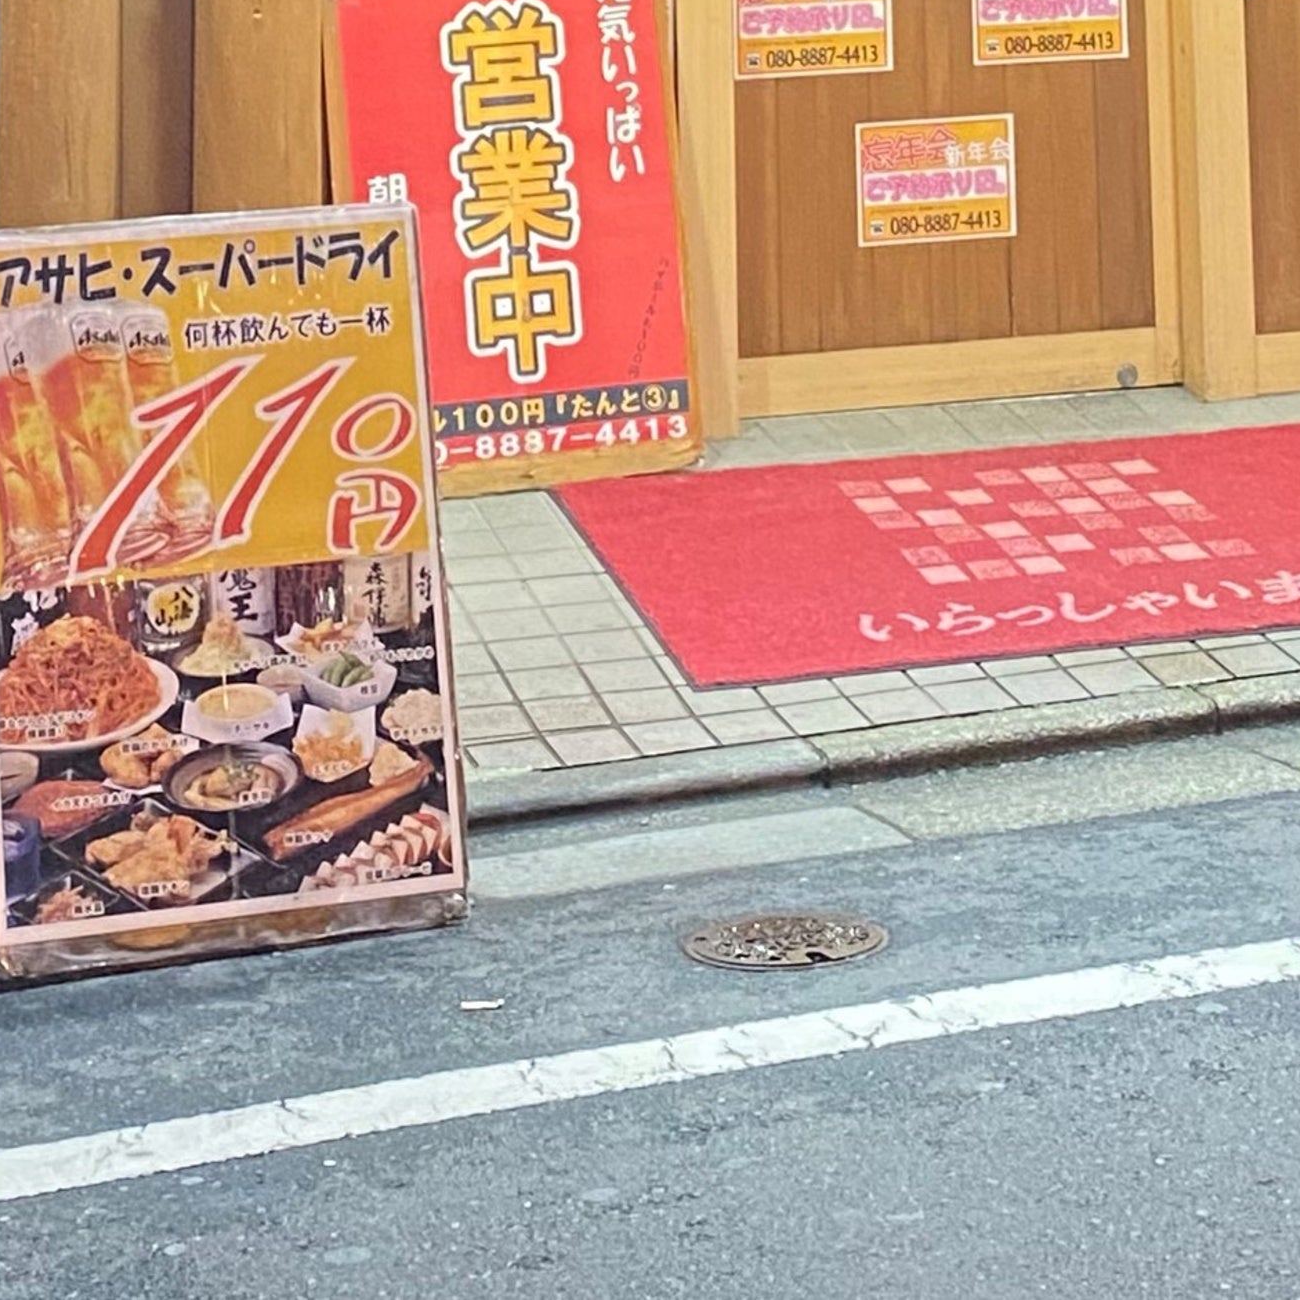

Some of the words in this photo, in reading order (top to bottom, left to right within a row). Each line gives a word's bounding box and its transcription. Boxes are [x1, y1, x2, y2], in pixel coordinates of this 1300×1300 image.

[1004, 31, 1114, 54] 080-8887-4413
[766, 45, 878, 68] 080-8887-4413
[890, 210, 1001, 235] 080-8887-4413
[184, 308, 393, 351] 何杯飲んでも一杯
